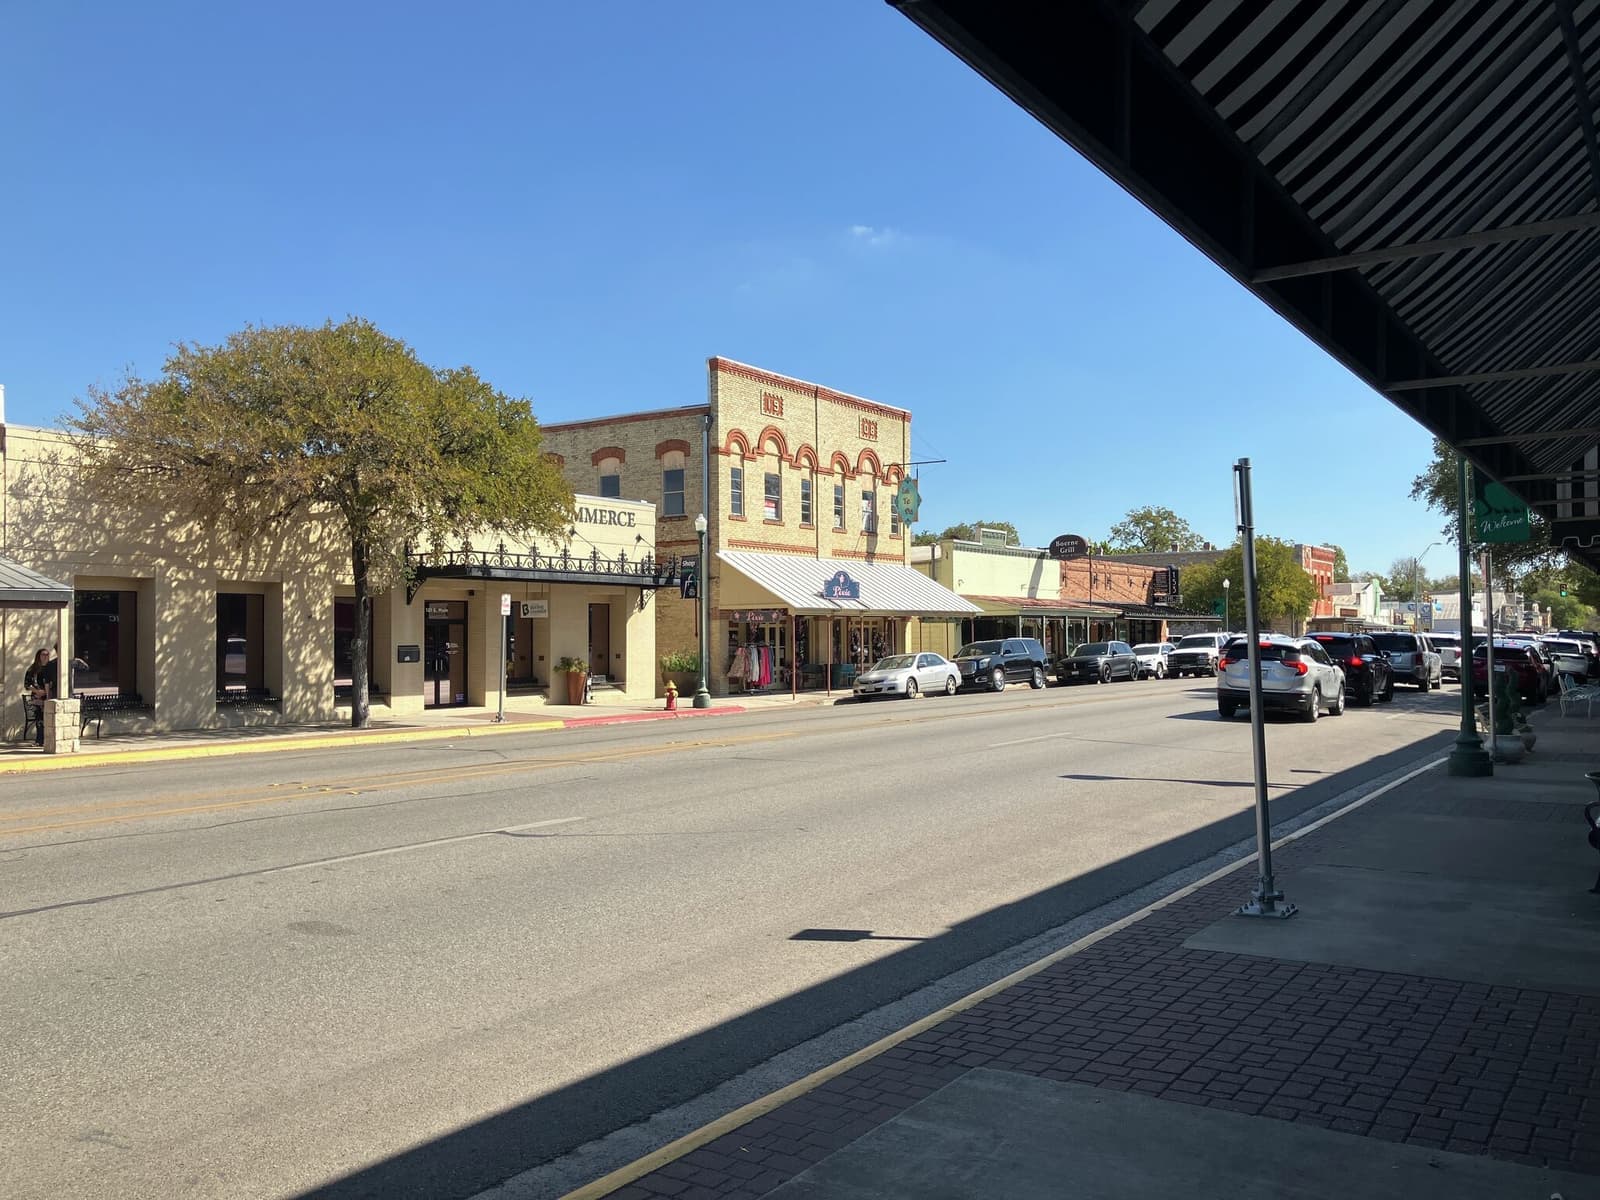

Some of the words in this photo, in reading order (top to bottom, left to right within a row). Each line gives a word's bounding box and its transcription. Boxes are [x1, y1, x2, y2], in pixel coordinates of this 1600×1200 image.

[571, 506, 636, 527] MMERCE
[1480, 515, 1523, 533] Welcome
[1059, 546, 1075, 554] Grill
